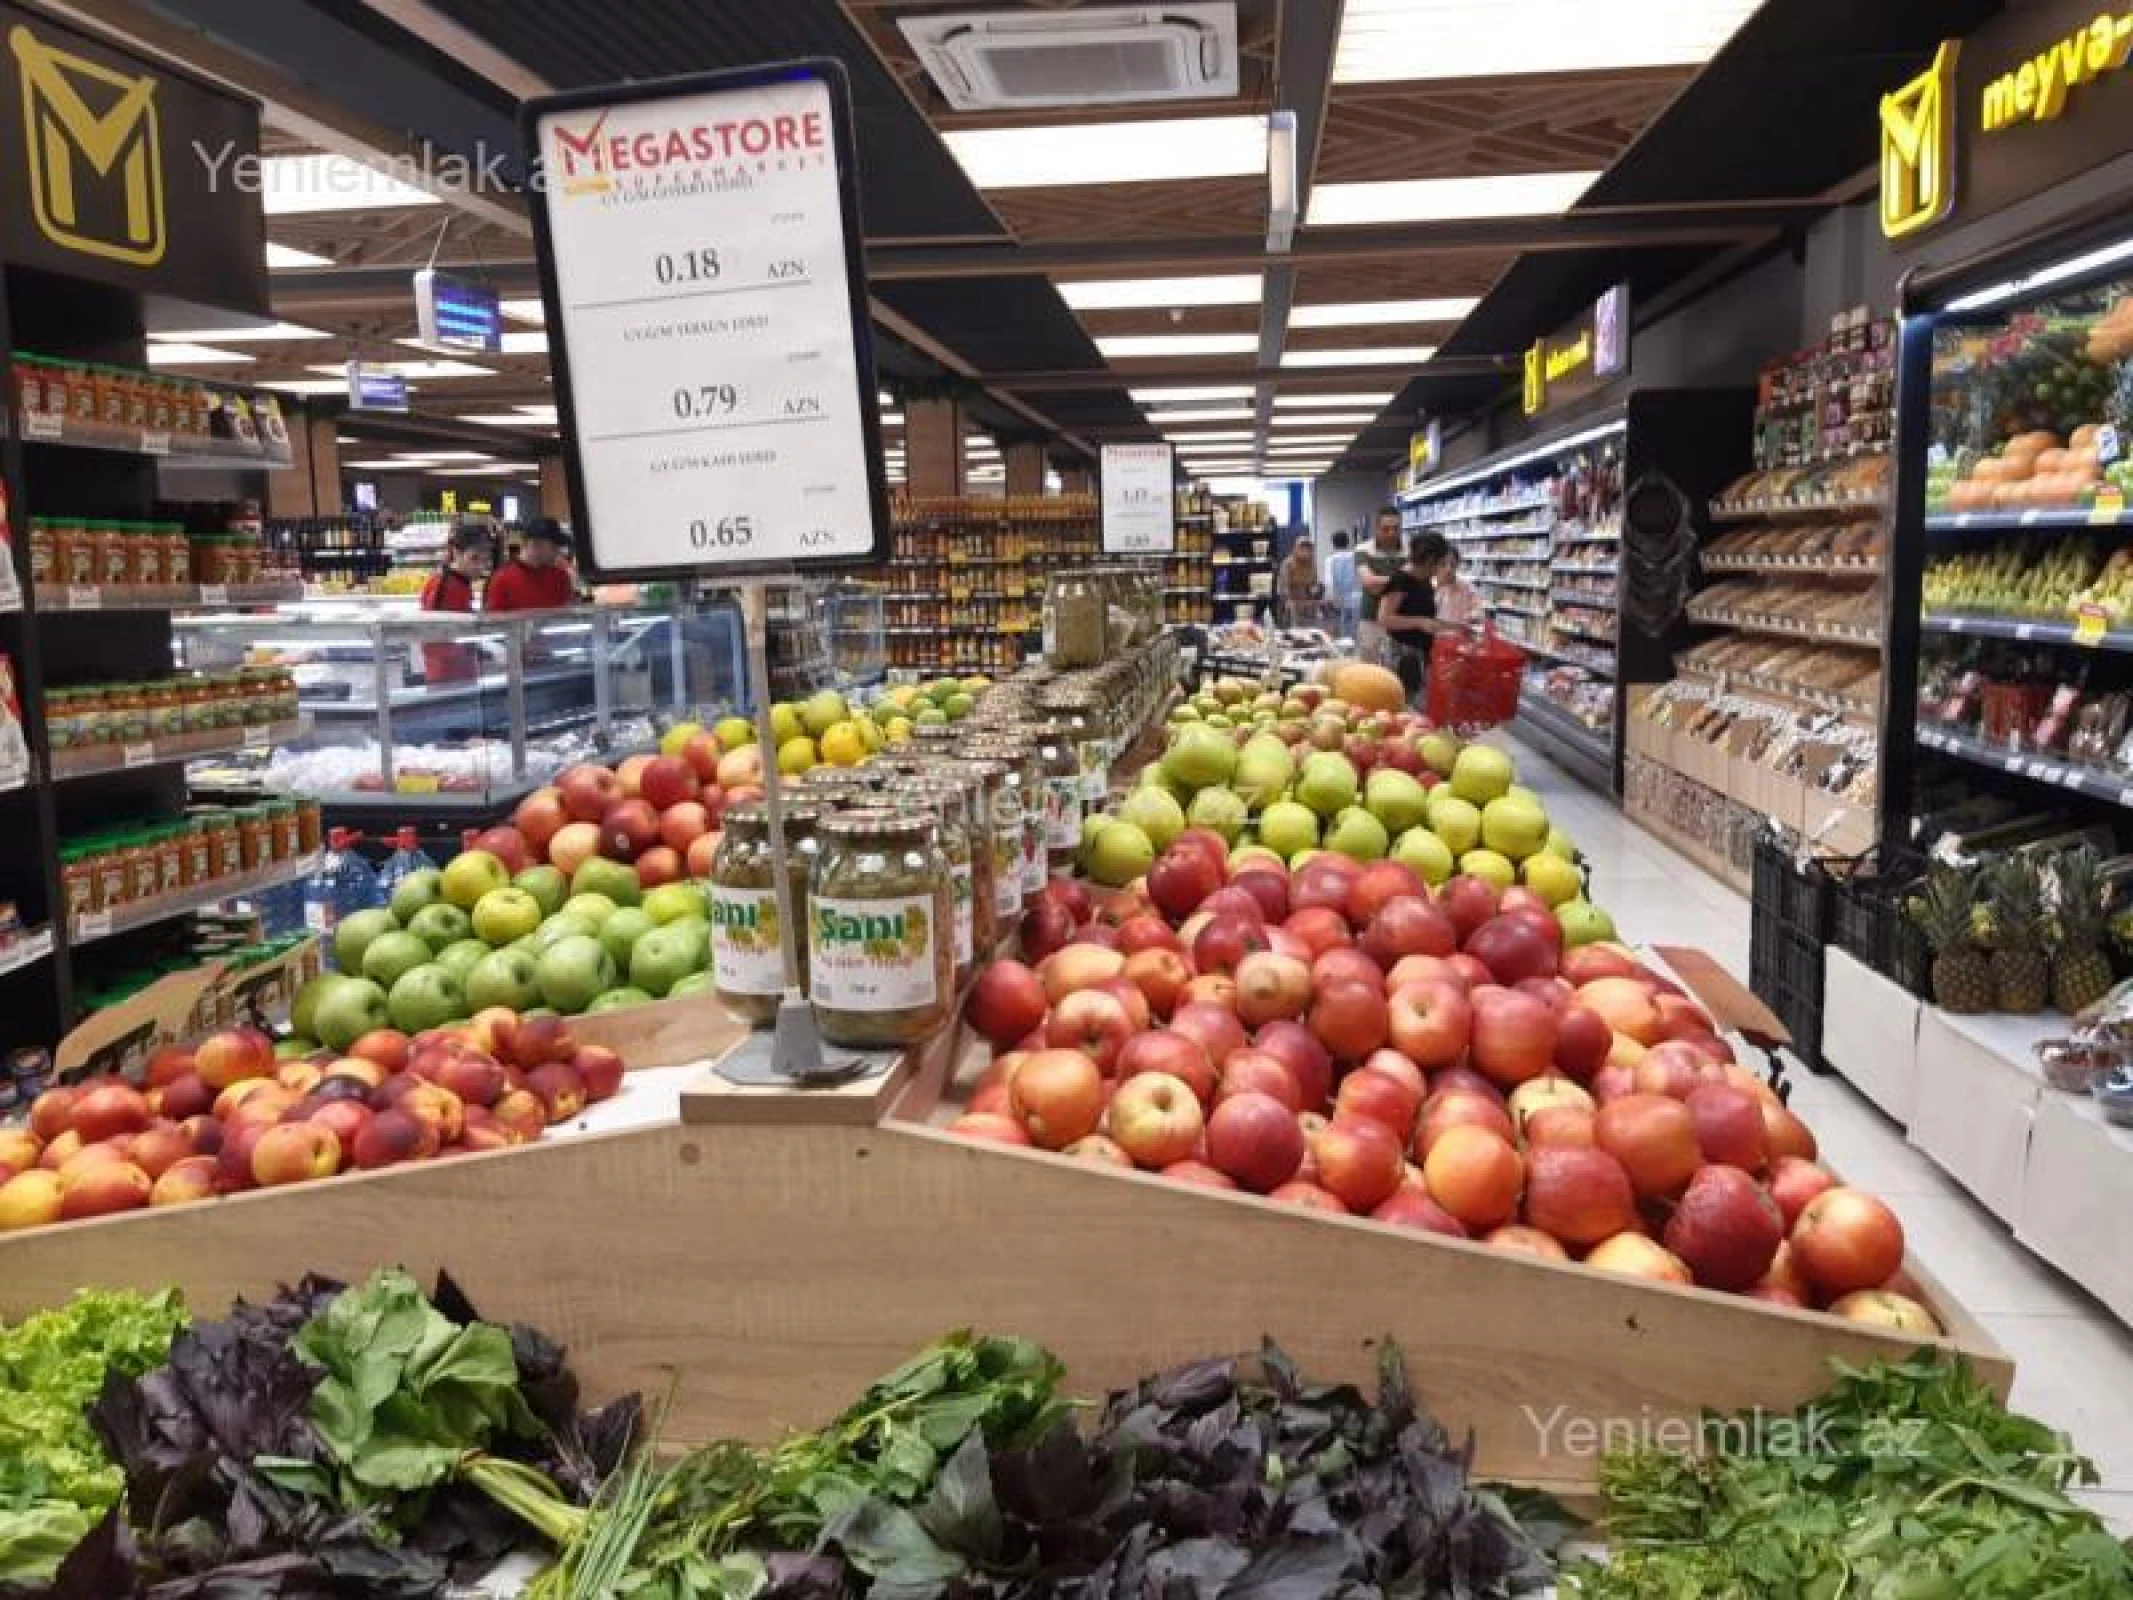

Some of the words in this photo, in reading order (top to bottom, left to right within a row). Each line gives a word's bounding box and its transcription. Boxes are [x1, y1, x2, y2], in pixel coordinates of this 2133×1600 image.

[554, 108, 825, 176] MEGASTORE
[655, 248, 720, 284] 0.18
[767, 260, 804, 280] AZN
[673, 383, 737, 418] 0.79
[783, 397, 820, 415] AZN
[690, 516, 752, 548] 0.65
